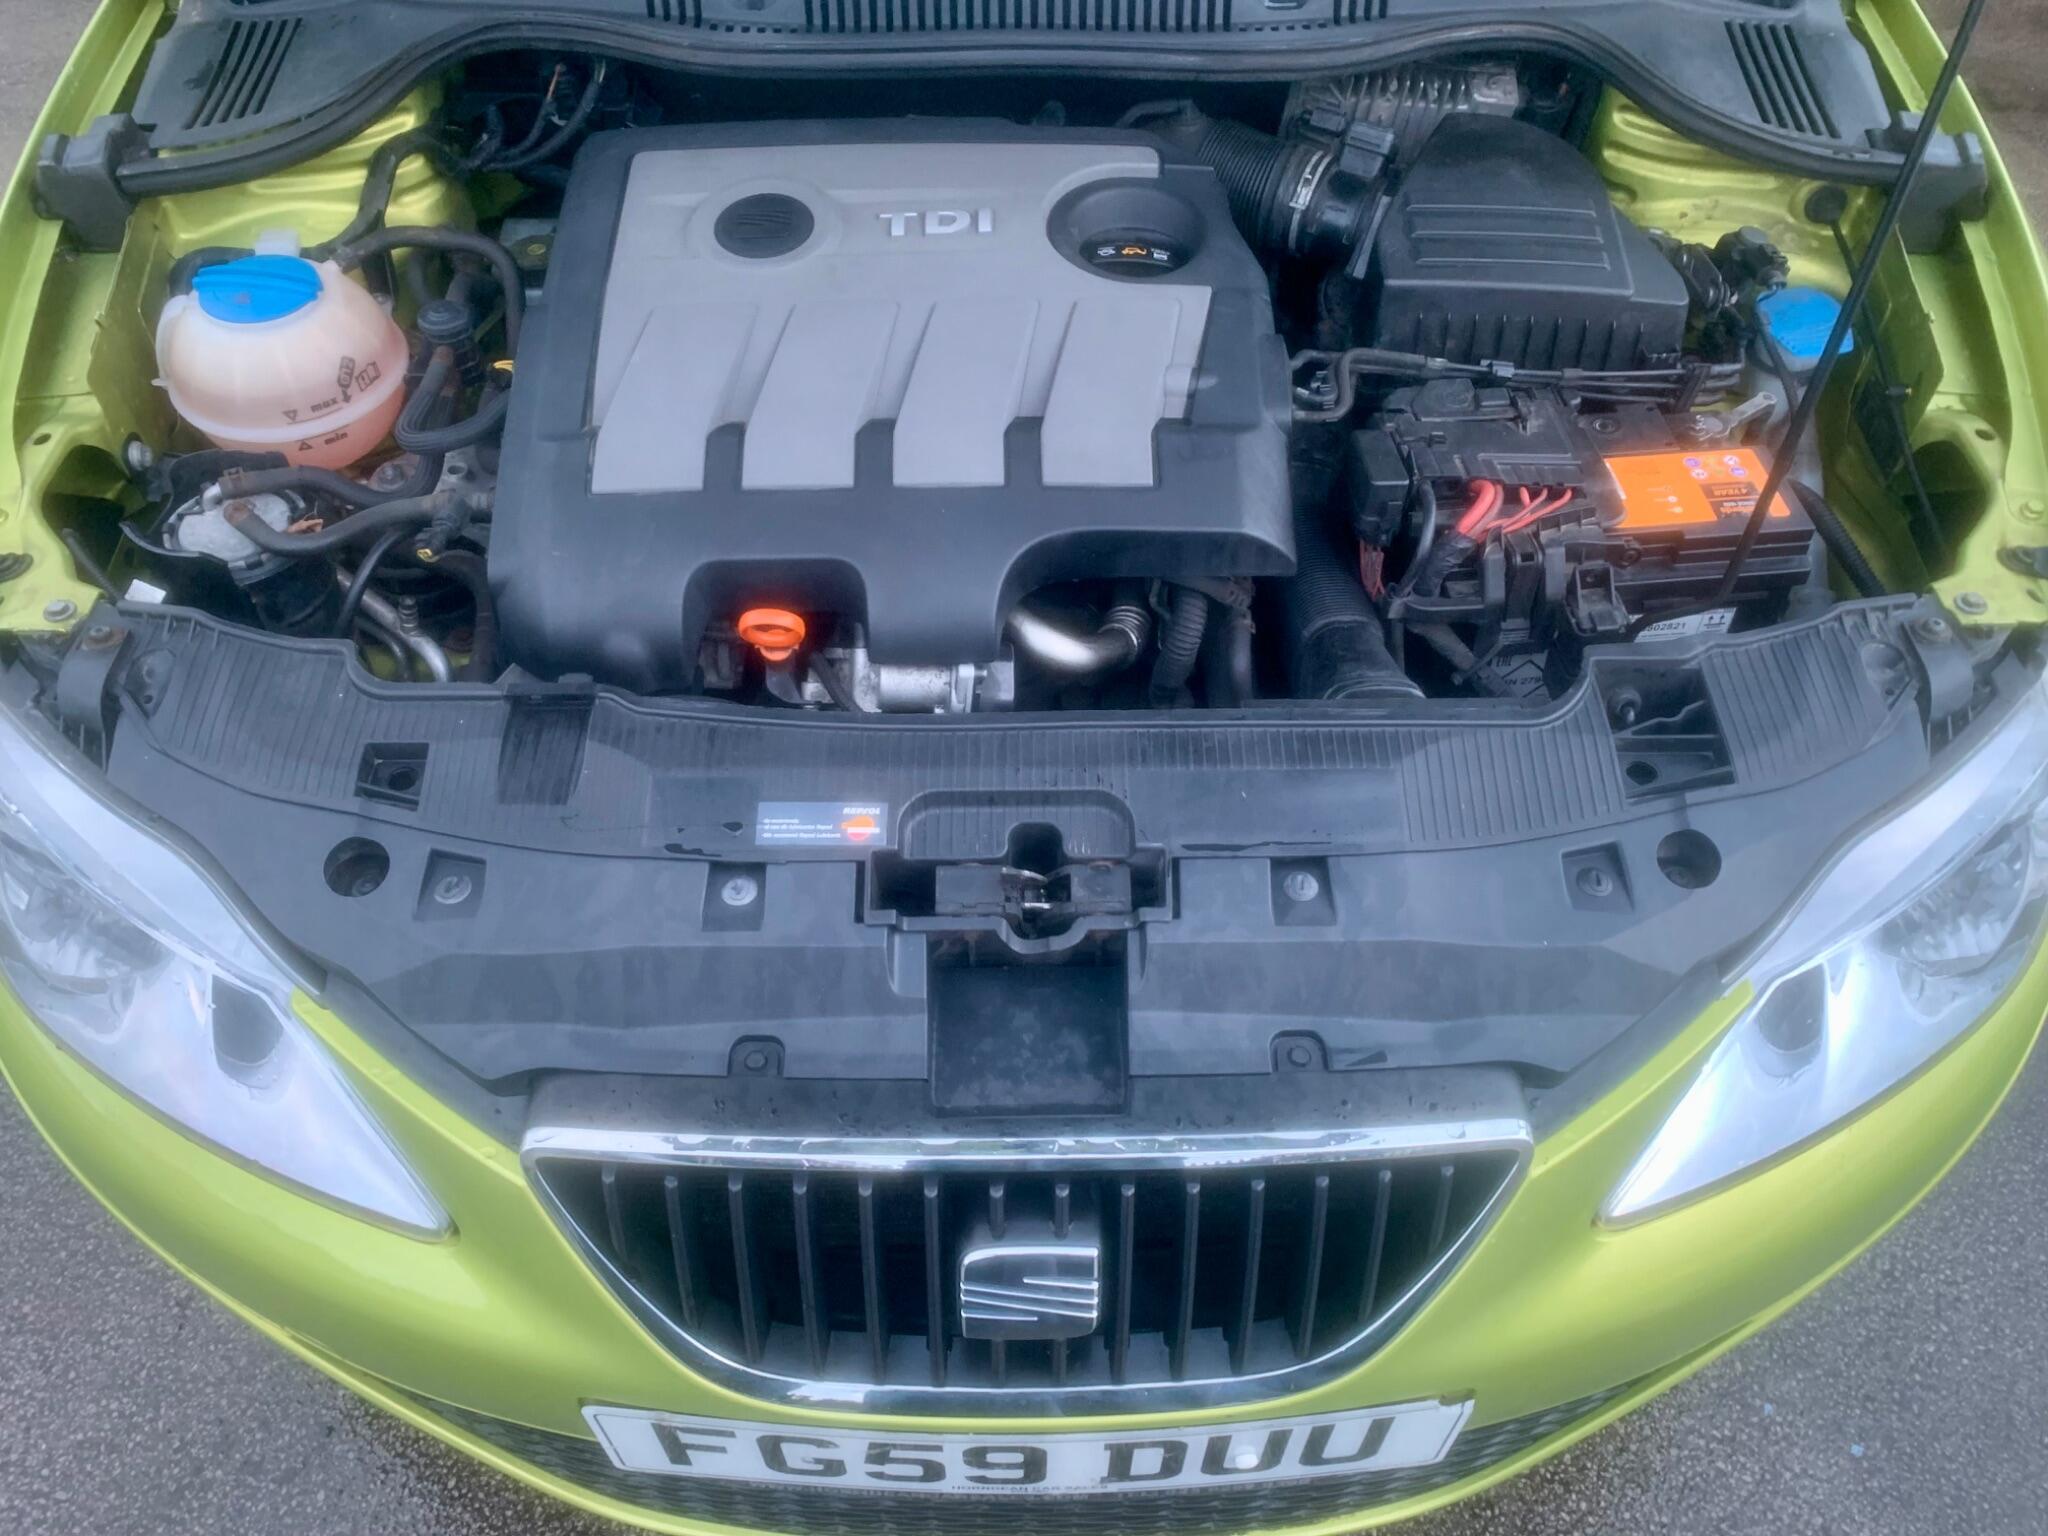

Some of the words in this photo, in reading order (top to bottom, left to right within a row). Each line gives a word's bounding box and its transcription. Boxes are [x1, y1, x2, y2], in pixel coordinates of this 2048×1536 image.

[879, 208, 993, 237] TDI
[310, 396, 338, 413] max
[323, 431, 349, 446] min
[651, 1422, 1048, 1485] FG59
[1101, 1416, 1396, 1482] DUU
